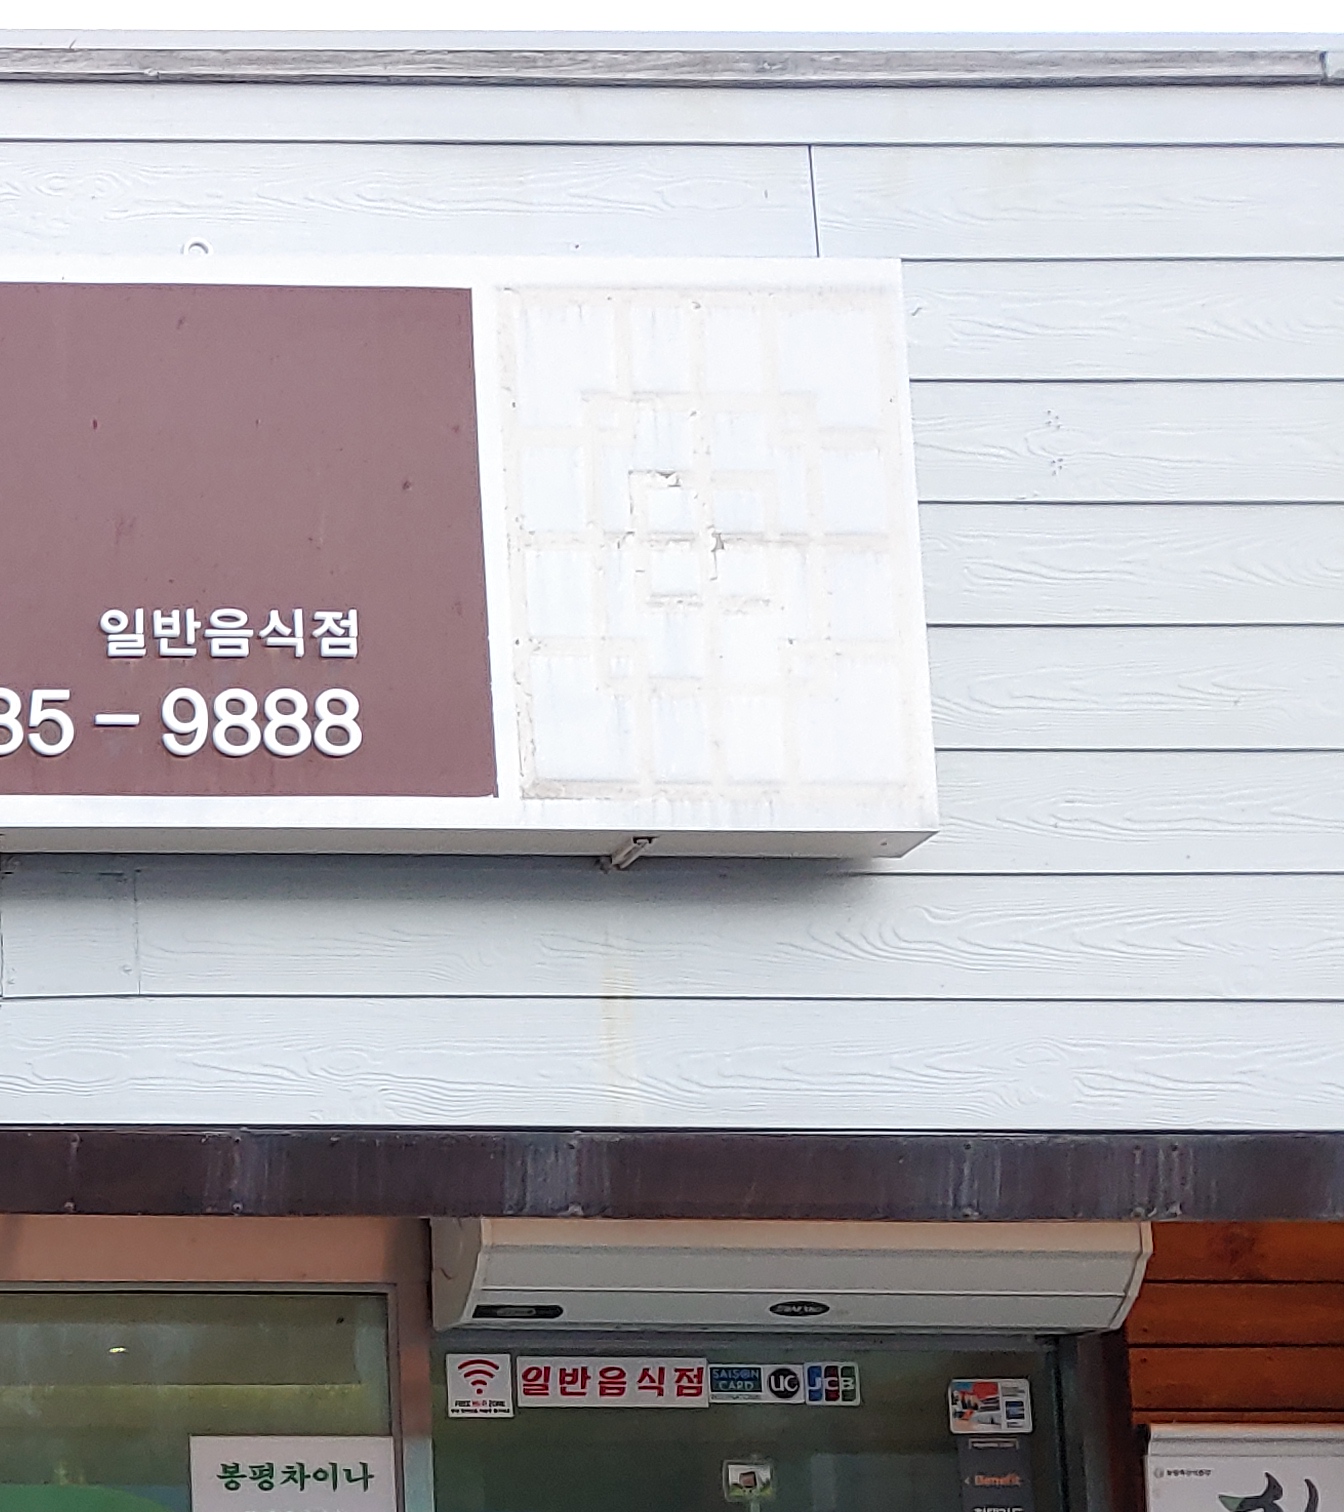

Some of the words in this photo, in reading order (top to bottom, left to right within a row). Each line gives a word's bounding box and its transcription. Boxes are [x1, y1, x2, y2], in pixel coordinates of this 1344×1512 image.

[98, 606, 360, 660] 일반음식점
[521, 1366, 705, 1398] 일반음식점
[712, 1368, 760, 1380] SAISON
[770, 1374, 800, 1393] UC
[718, 1381, 754, 1392] CARD
[216, 1462, 375, 1492] 봉평차이나
